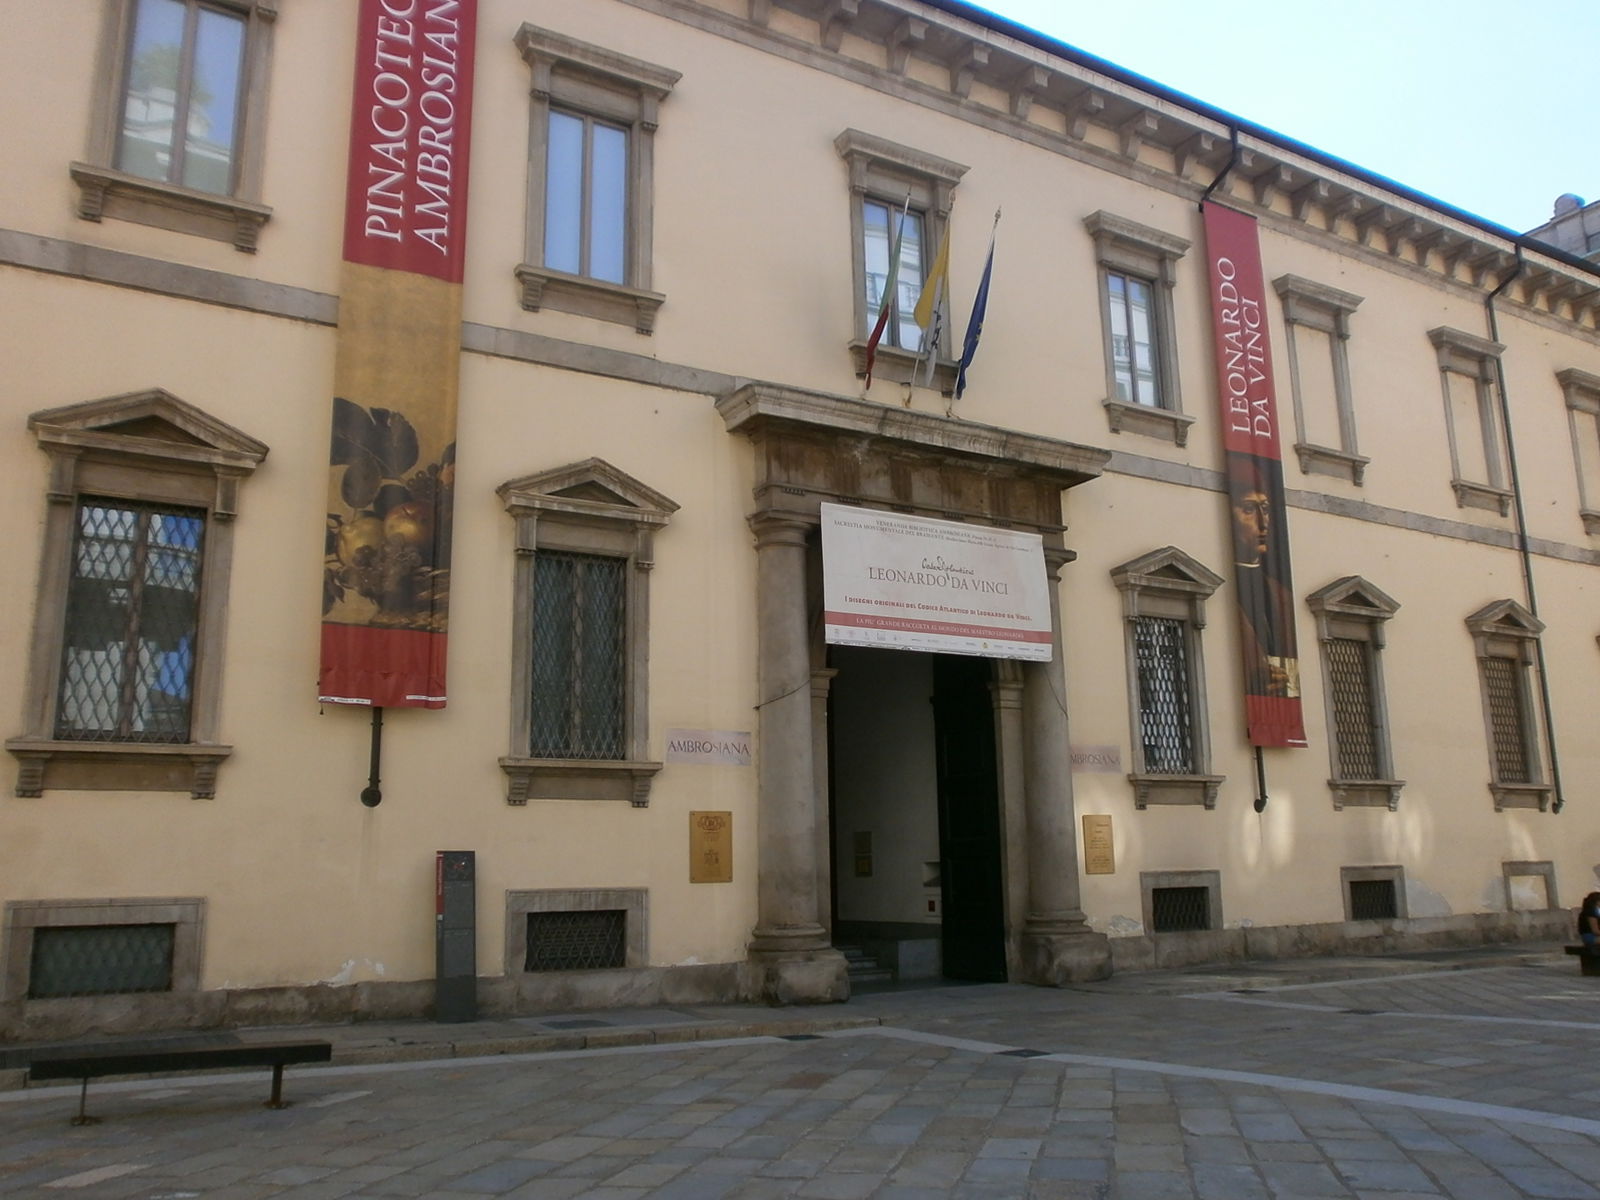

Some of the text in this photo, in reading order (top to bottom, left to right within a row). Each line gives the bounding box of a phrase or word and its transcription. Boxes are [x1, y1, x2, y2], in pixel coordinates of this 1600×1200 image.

[1217, 257, 1251, 435] LEONARDO
[1242, 296, 1272, 439] DA VINCI
[869, 567, 1008, 595] LEONARDO DA VINCI
[849, 597, 873, 605] DISEGNI
[874, 599, 904, 608] ORIGINALI
[668, 740, 751, 757] AMBROSIANA
[1070, 752, 1120, 769] MBROSIANA
